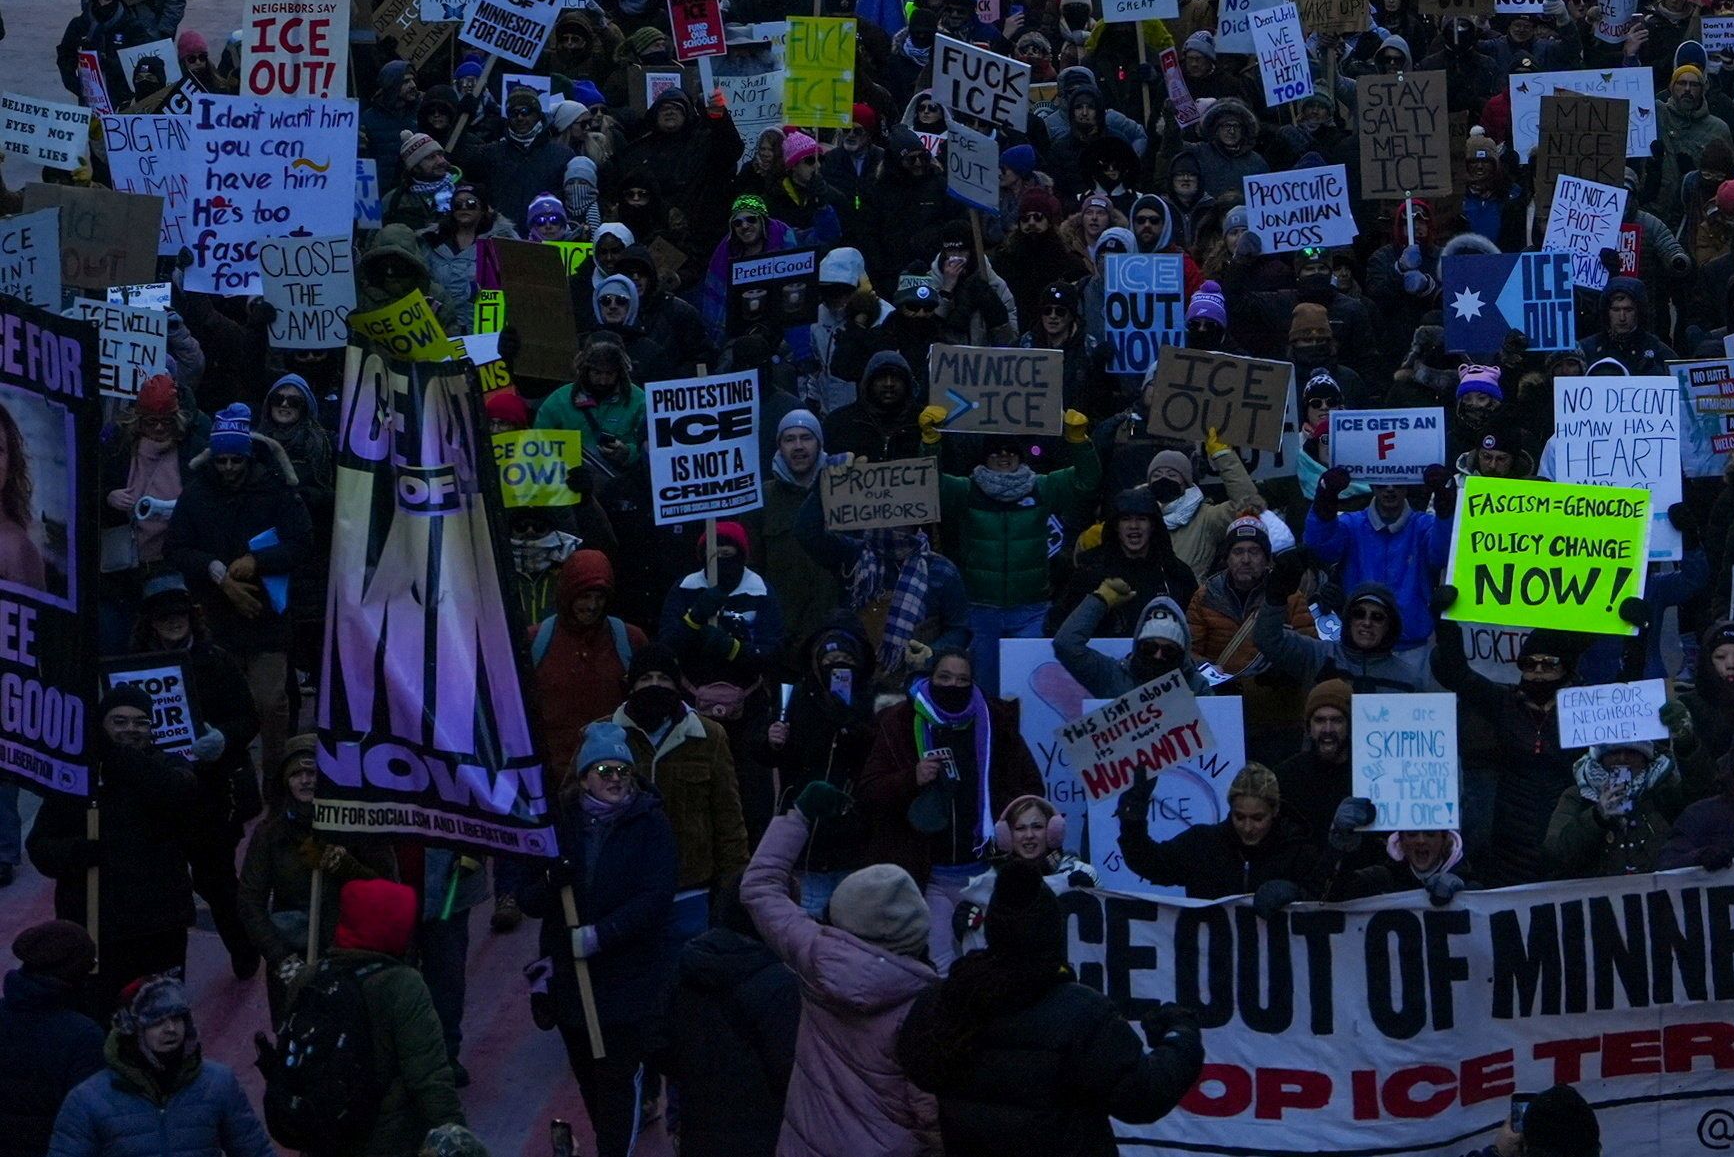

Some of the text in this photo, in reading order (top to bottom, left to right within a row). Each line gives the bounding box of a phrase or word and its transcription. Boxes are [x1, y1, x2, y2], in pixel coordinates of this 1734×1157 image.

[252, 2, 337, 14] NEIGHBORS SAY
[476, 0, 545, 43] MINNESOTA
[251, 19, 330, 54] ICE
[466, 19, 534, 61] FOR GOOD!
[248, 61, 334, 98] OUT!
[941, 51, 1026, 96] FUCK
[951, 79, 1015, 125] ICE
[1368, 78, 1430, 107] STAY
[1362, 107, 1440, 132] SALTY
[1372, 133, 1439, 159] MELT
[1372, 157, 1439, 193] ICE
[1249, 176, 1343, 208] PROSECUTE
[1272, 225, 1323, 248] ROSS
[260, 244, 349, 276] CLOSE
[733, 256, 814, 279] Pretti Good
[285, 280, 331, 306] THE
[271, 306, 347, 340] CAMPS
[1180, 354, 1275, 401] ICE
[652, 379, 752, 413] PROTESTING
[1563, 387, 1678, 416] NO DECENT
[655, 407, 752, 447] ICE
[1163, 394, 1272, 435] OUT
[1557, 420, 1674, 439] HUMAN HAS A
[672, 447, 745, 483] IS NOT A
[1567, 437, 1676, 479] HEART
[659, 474, 756, 501] CRIME!
[829, 466, 928, 494] PROTECT
[864, 490, 893, 501] OUR
[829, 503, 928, 524] NEIGHBORS
[1471, 531, 1631, 558] POLICY CHANGE
[1475, 563, 1632, 611] NOW!
[1563, 686, 1643, 708] LEAVE OUR
[1573, 701, 1652, 722] NEIGHBORS
[1574, 720, 1637, 742] ALONE!
[1067, 890, 1162, 1024] CE
[1176, 904, 1357, 1035] OUT
[1367, 907, 1471, 1037] OF
[1202, 1063, 1331, 1119] OP
[1352, 1052, 1513, 1119] ICE
